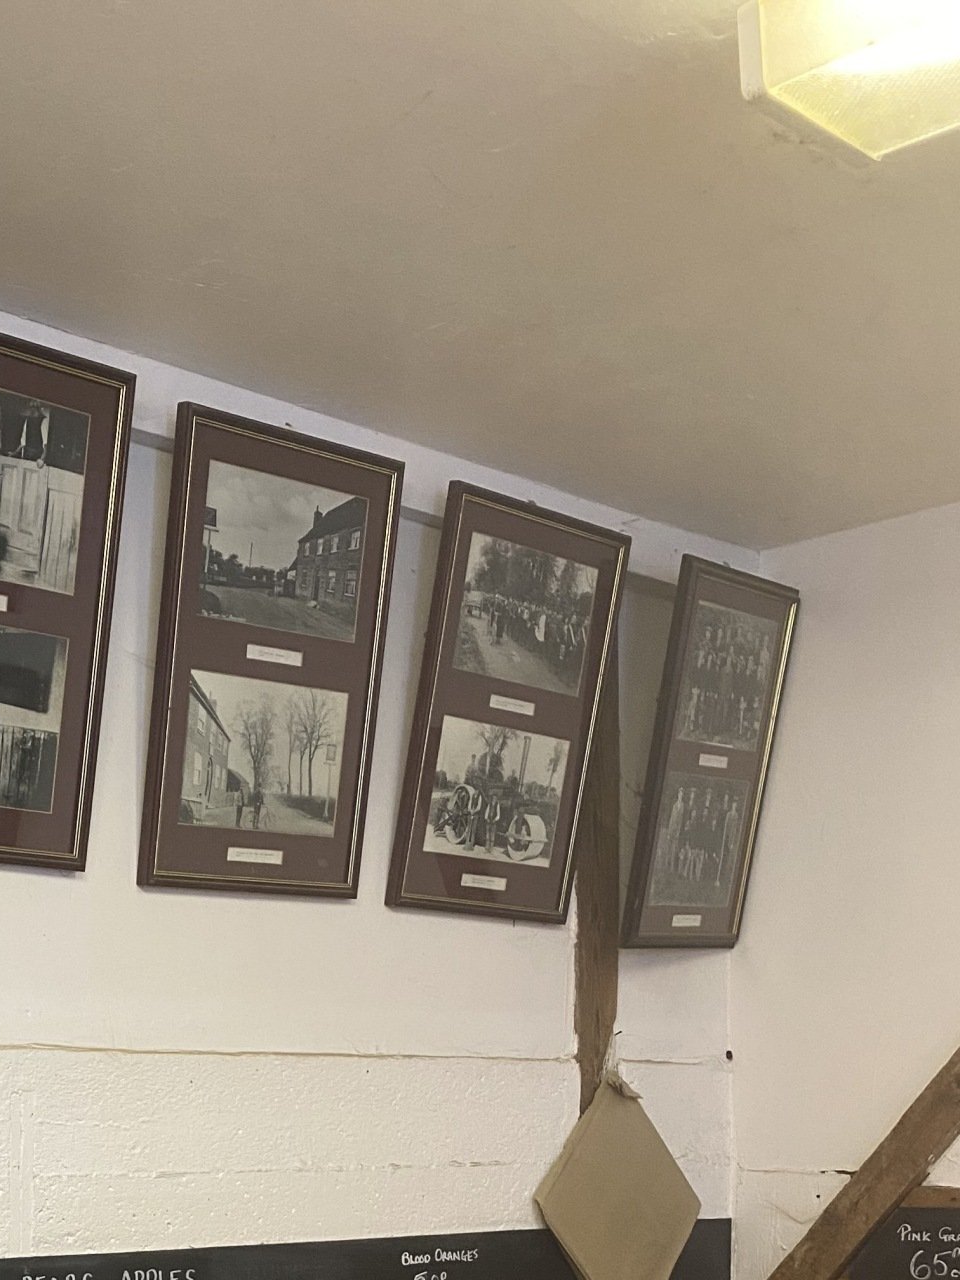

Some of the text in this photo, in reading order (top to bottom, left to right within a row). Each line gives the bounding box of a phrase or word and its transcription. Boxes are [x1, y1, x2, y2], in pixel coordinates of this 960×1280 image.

[896, 1223, 931, 1242] PINK
[401, 1248, 478, 1266] BLOOD ORANGES
